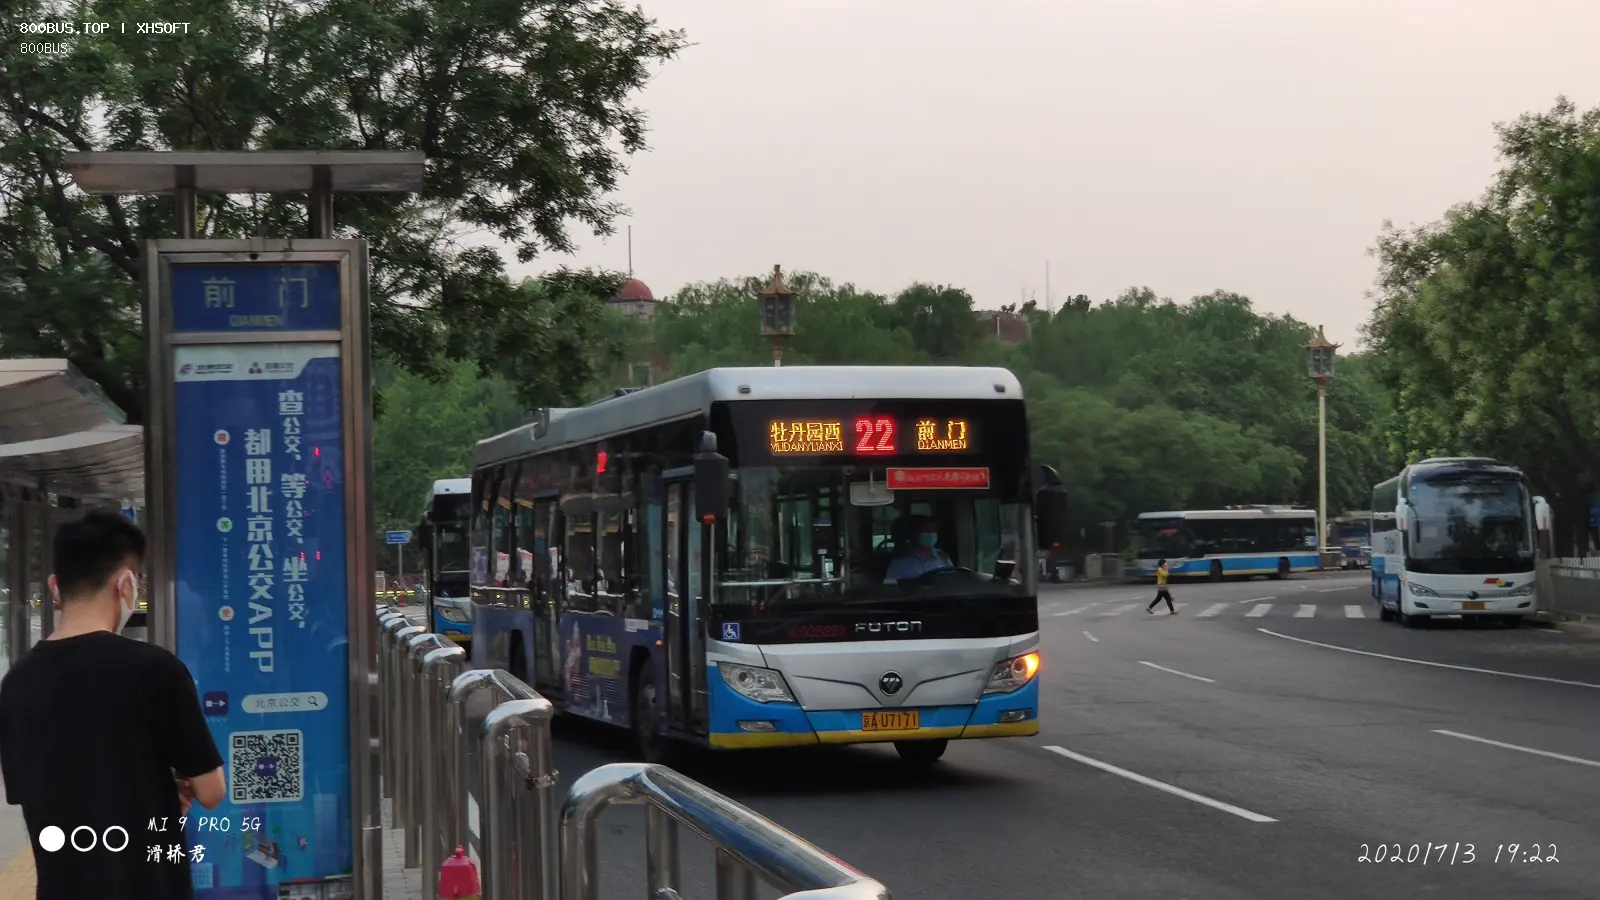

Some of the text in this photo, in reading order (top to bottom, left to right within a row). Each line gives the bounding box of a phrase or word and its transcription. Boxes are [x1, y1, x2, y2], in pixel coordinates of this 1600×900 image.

[202, 276, 309, 309] 前门
[770, 422, 841, 442] 牡丹园西
[855, 419, 895, 451] 22
[915, 420, 966, 440] 前门
[917, 439, 967, 450] QIANMEN
[854, 620, 923, 633] FOTON
[254, 696, 301, 710] 北京公交
